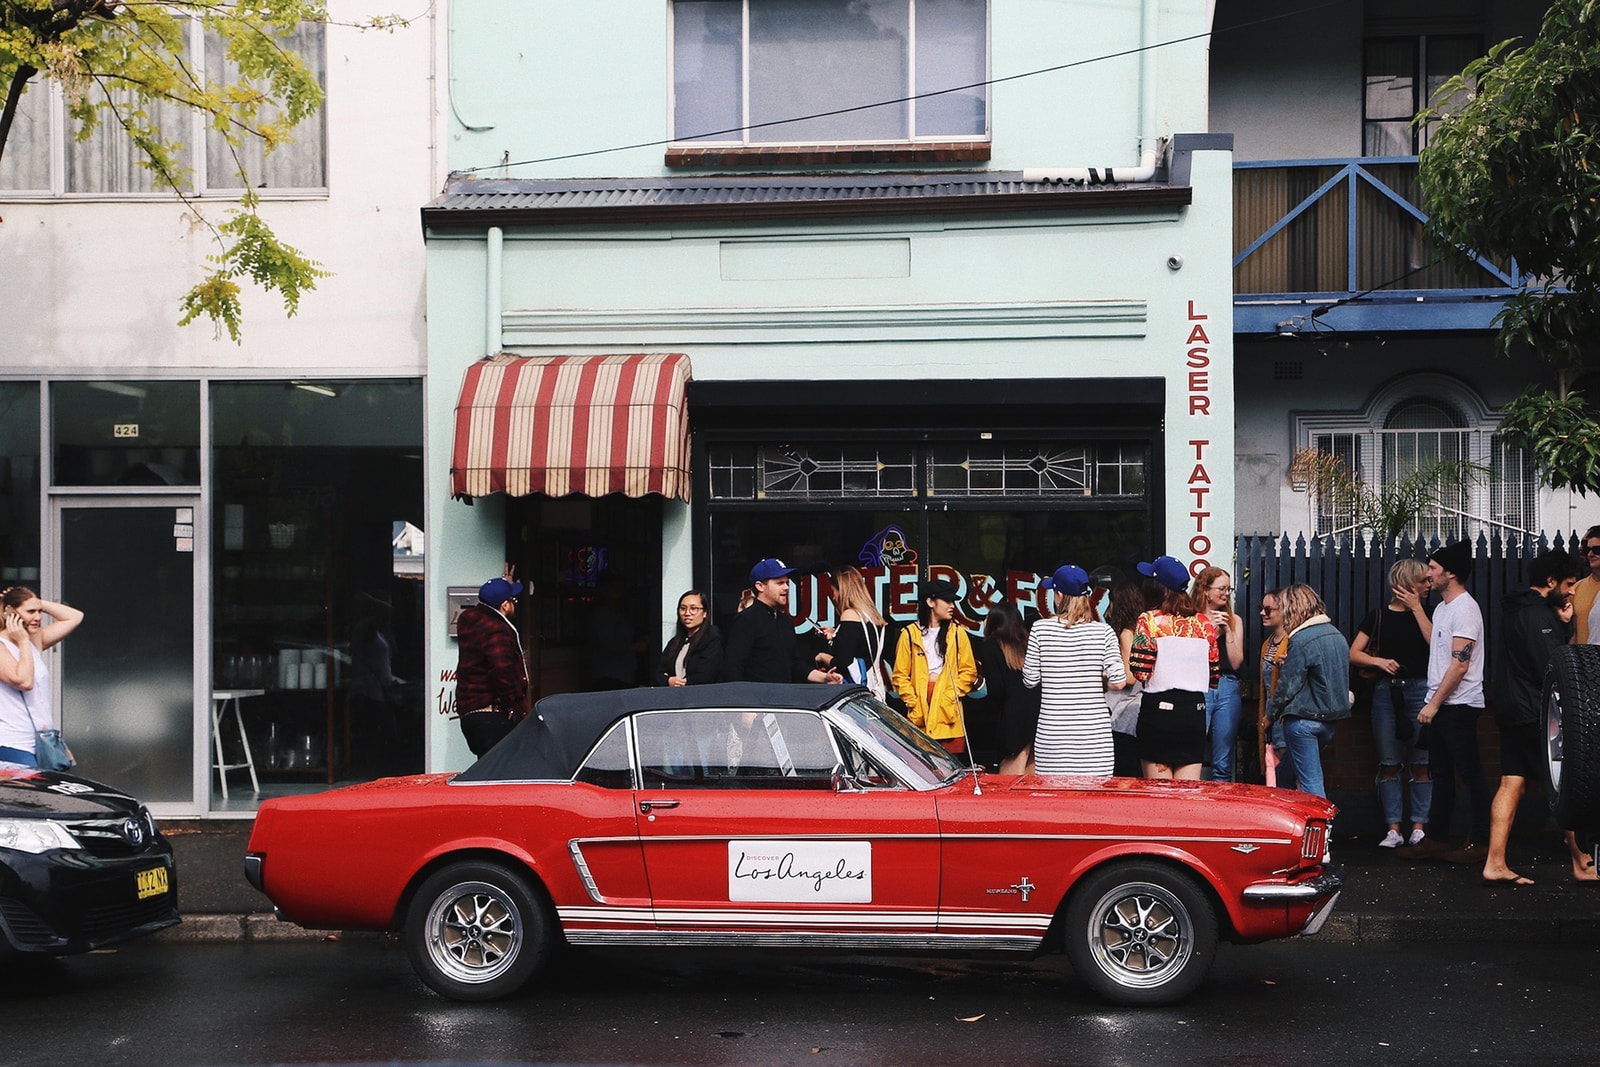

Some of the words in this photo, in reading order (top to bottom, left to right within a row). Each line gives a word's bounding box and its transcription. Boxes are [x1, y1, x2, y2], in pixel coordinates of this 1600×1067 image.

[1186, 300, 1210, 415] LASER
[115, 426, 137, 435] 424
[735, 851, 777, 880] Los
[777, 852, 865, 892] Angeles
